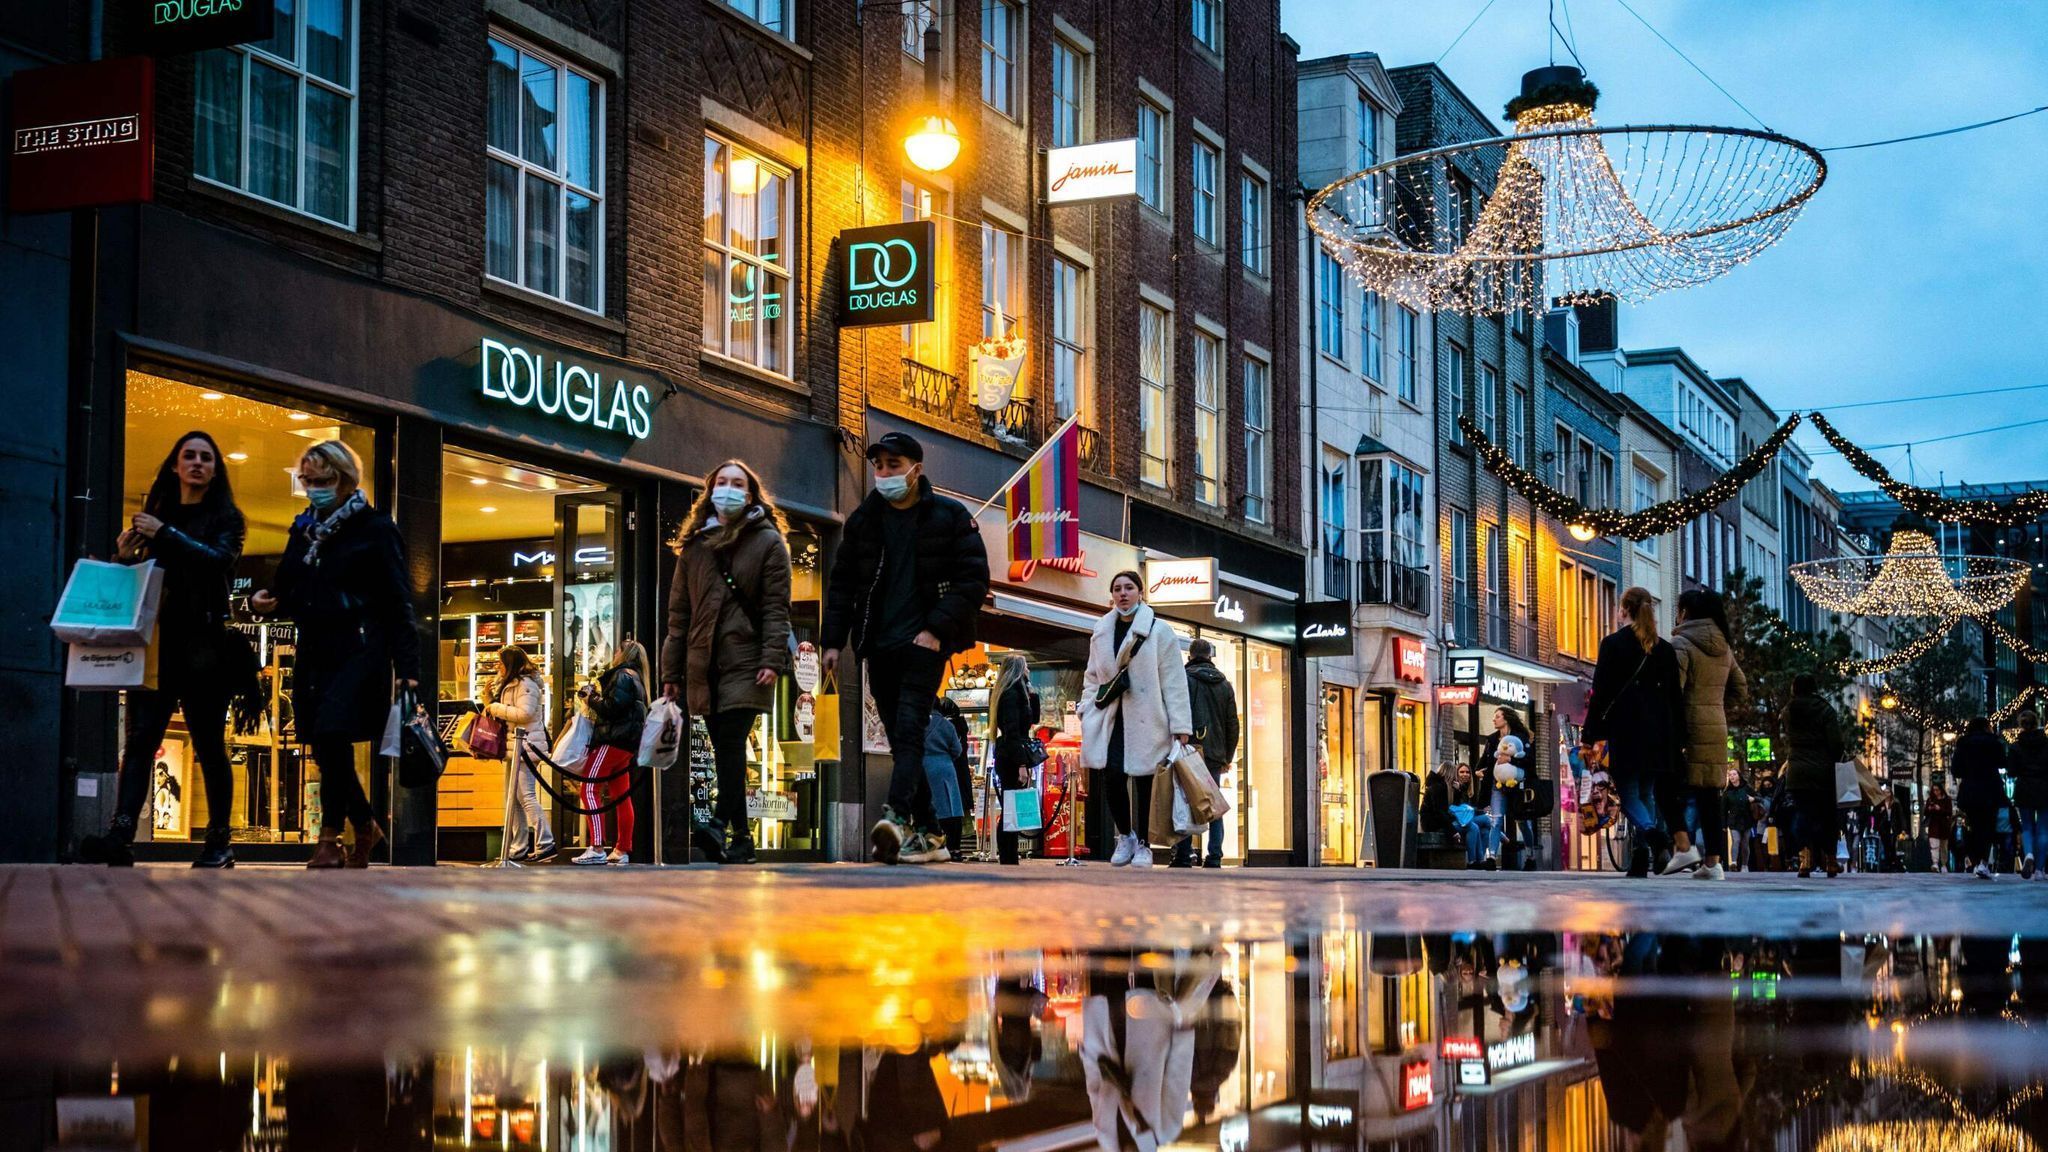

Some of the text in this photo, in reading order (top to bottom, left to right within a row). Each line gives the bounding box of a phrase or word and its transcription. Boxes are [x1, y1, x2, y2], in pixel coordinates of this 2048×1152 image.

[155, 0, 241, 24] DOUGLAS
[19, 130, 60, 148] THE
[67, 121, 133, 142] STING
[1052, 161, 1133, 192] jamin
[849, 289, 917, 310] DOUGLAS
[482, 337, 650, 440] DOUGLAS
[1150, 573, 1208, 593] jamin
[1303, 623, 1346, 638] Clarks
[762, 796, 788, 812] korting
